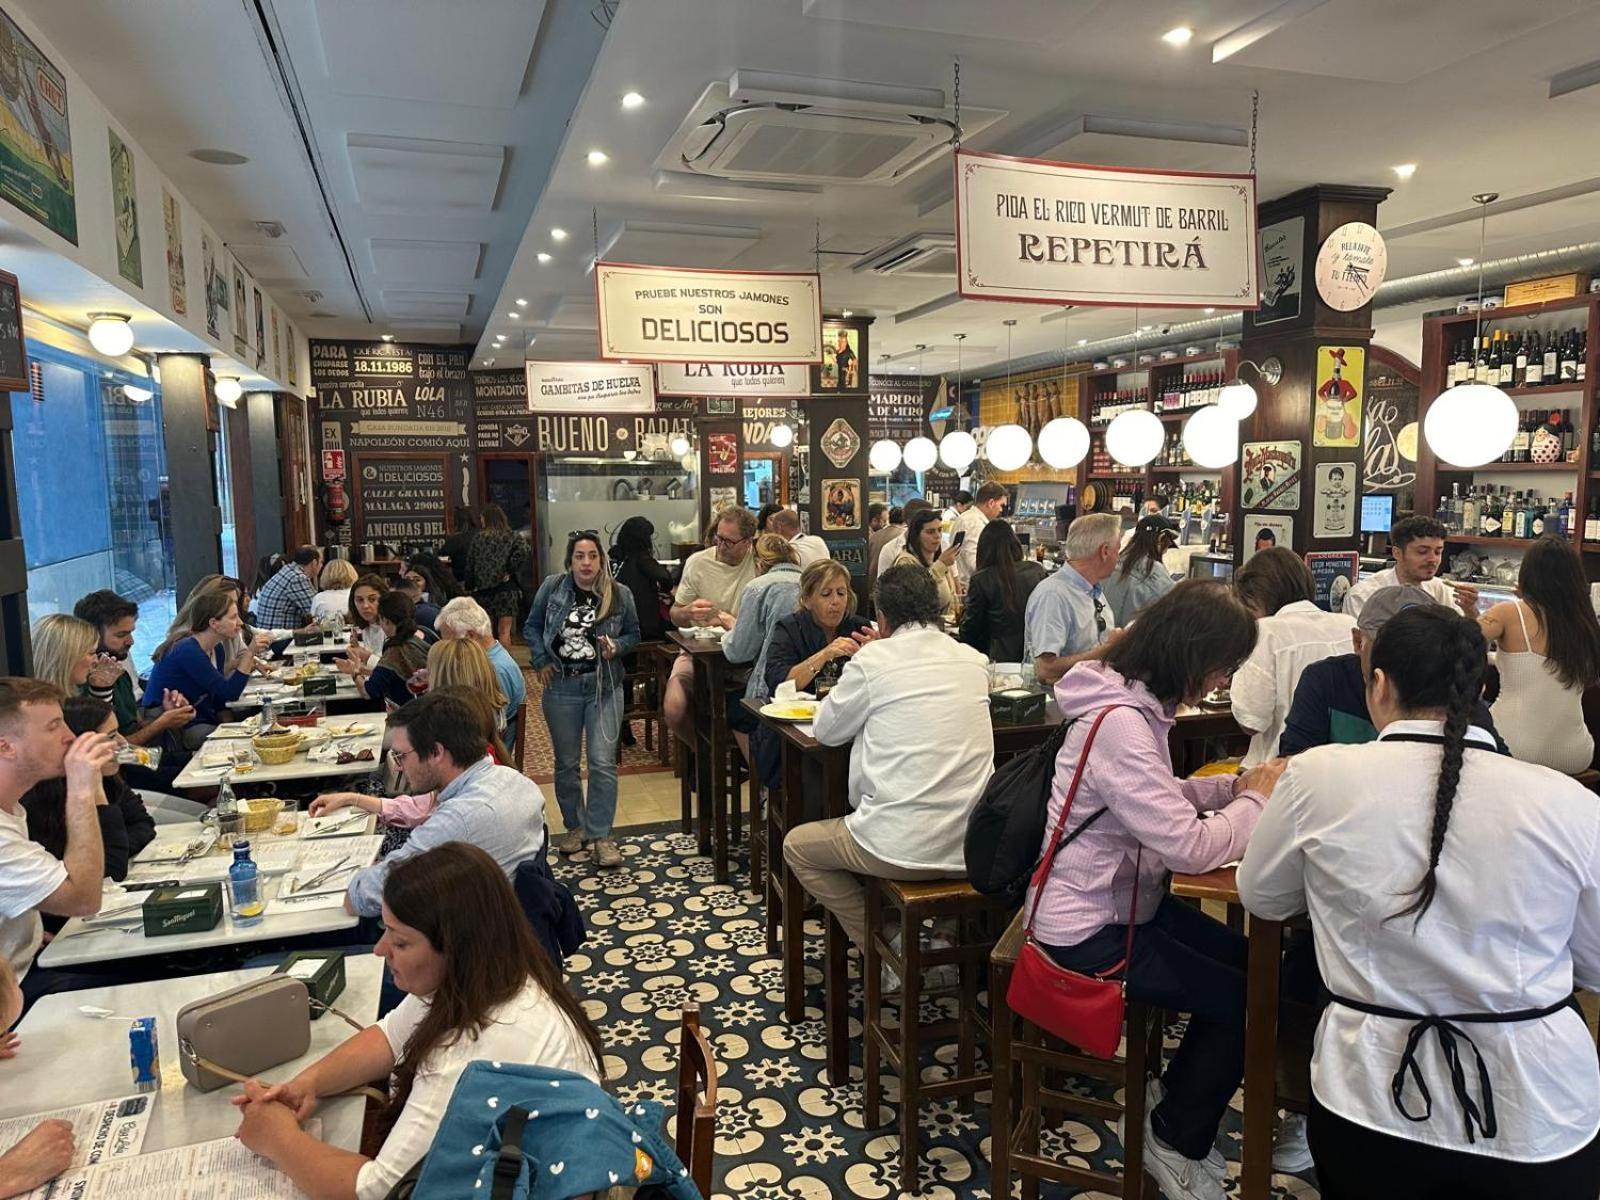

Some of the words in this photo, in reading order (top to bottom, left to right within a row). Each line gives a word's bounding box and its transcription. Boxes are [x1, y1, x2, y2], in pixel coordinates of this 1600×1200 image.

[996, 193, 1027, 220] PIDA
[1033, 198, 1050, 221] EL
[1055, 200, 1086, 224] RICO
[1091, 202, 1151, 228] VERMUT
[1156, 207, 1173, 229] DE
[1178, 208, 1229, 231] BARRIL
[1018, 232, 1208, 270] REPETIRÁ
[635, 288, 677, 300] PRUEBE
[680, 288, 736, 299] NUESTROS
[739, 291, 790, 306] JAMONES
[698, 304, 722, 315] SON
[641, 317, 789, 344] DELICIOSOS
[312, 345, 347, 359] PARA
[313, 360, 348, 368] CHUPARSE
[354, 360, 413, 374] 18.11.1986
[541, 382, 590, 396] GAMBITAS
[592, 381, 605, 391] DE
[606, 376, 641, 389] HUELVA
[731, 378, 743, 388] que
[745, 376, 761, 386] todos
[762, 376, 785, 387] quieren
[415, 386, 445, 401] LOLA
[476, 384, 527, 397] MONTADITO
[319, 390, 345, 409] LA
[352, 389, 408, 408] RUBIA
[537, 416, 608, 452] BUENO
[635, 417, 696, 451] BARAT
[350, 437, 405, 448] NAPOLEÓN
[408, 436, 443, 447] COMIÓ
[446, 437, 470, 448] AQUÍ
[384, 472, 444, 482] DELICIOSOS
[364, 489, 395, 498] CALLE
[398, 489, 444, 497] GRANADA
[366, 523, 421, 537] ANCHOAS
[424, 522, 445, 537] DEL
